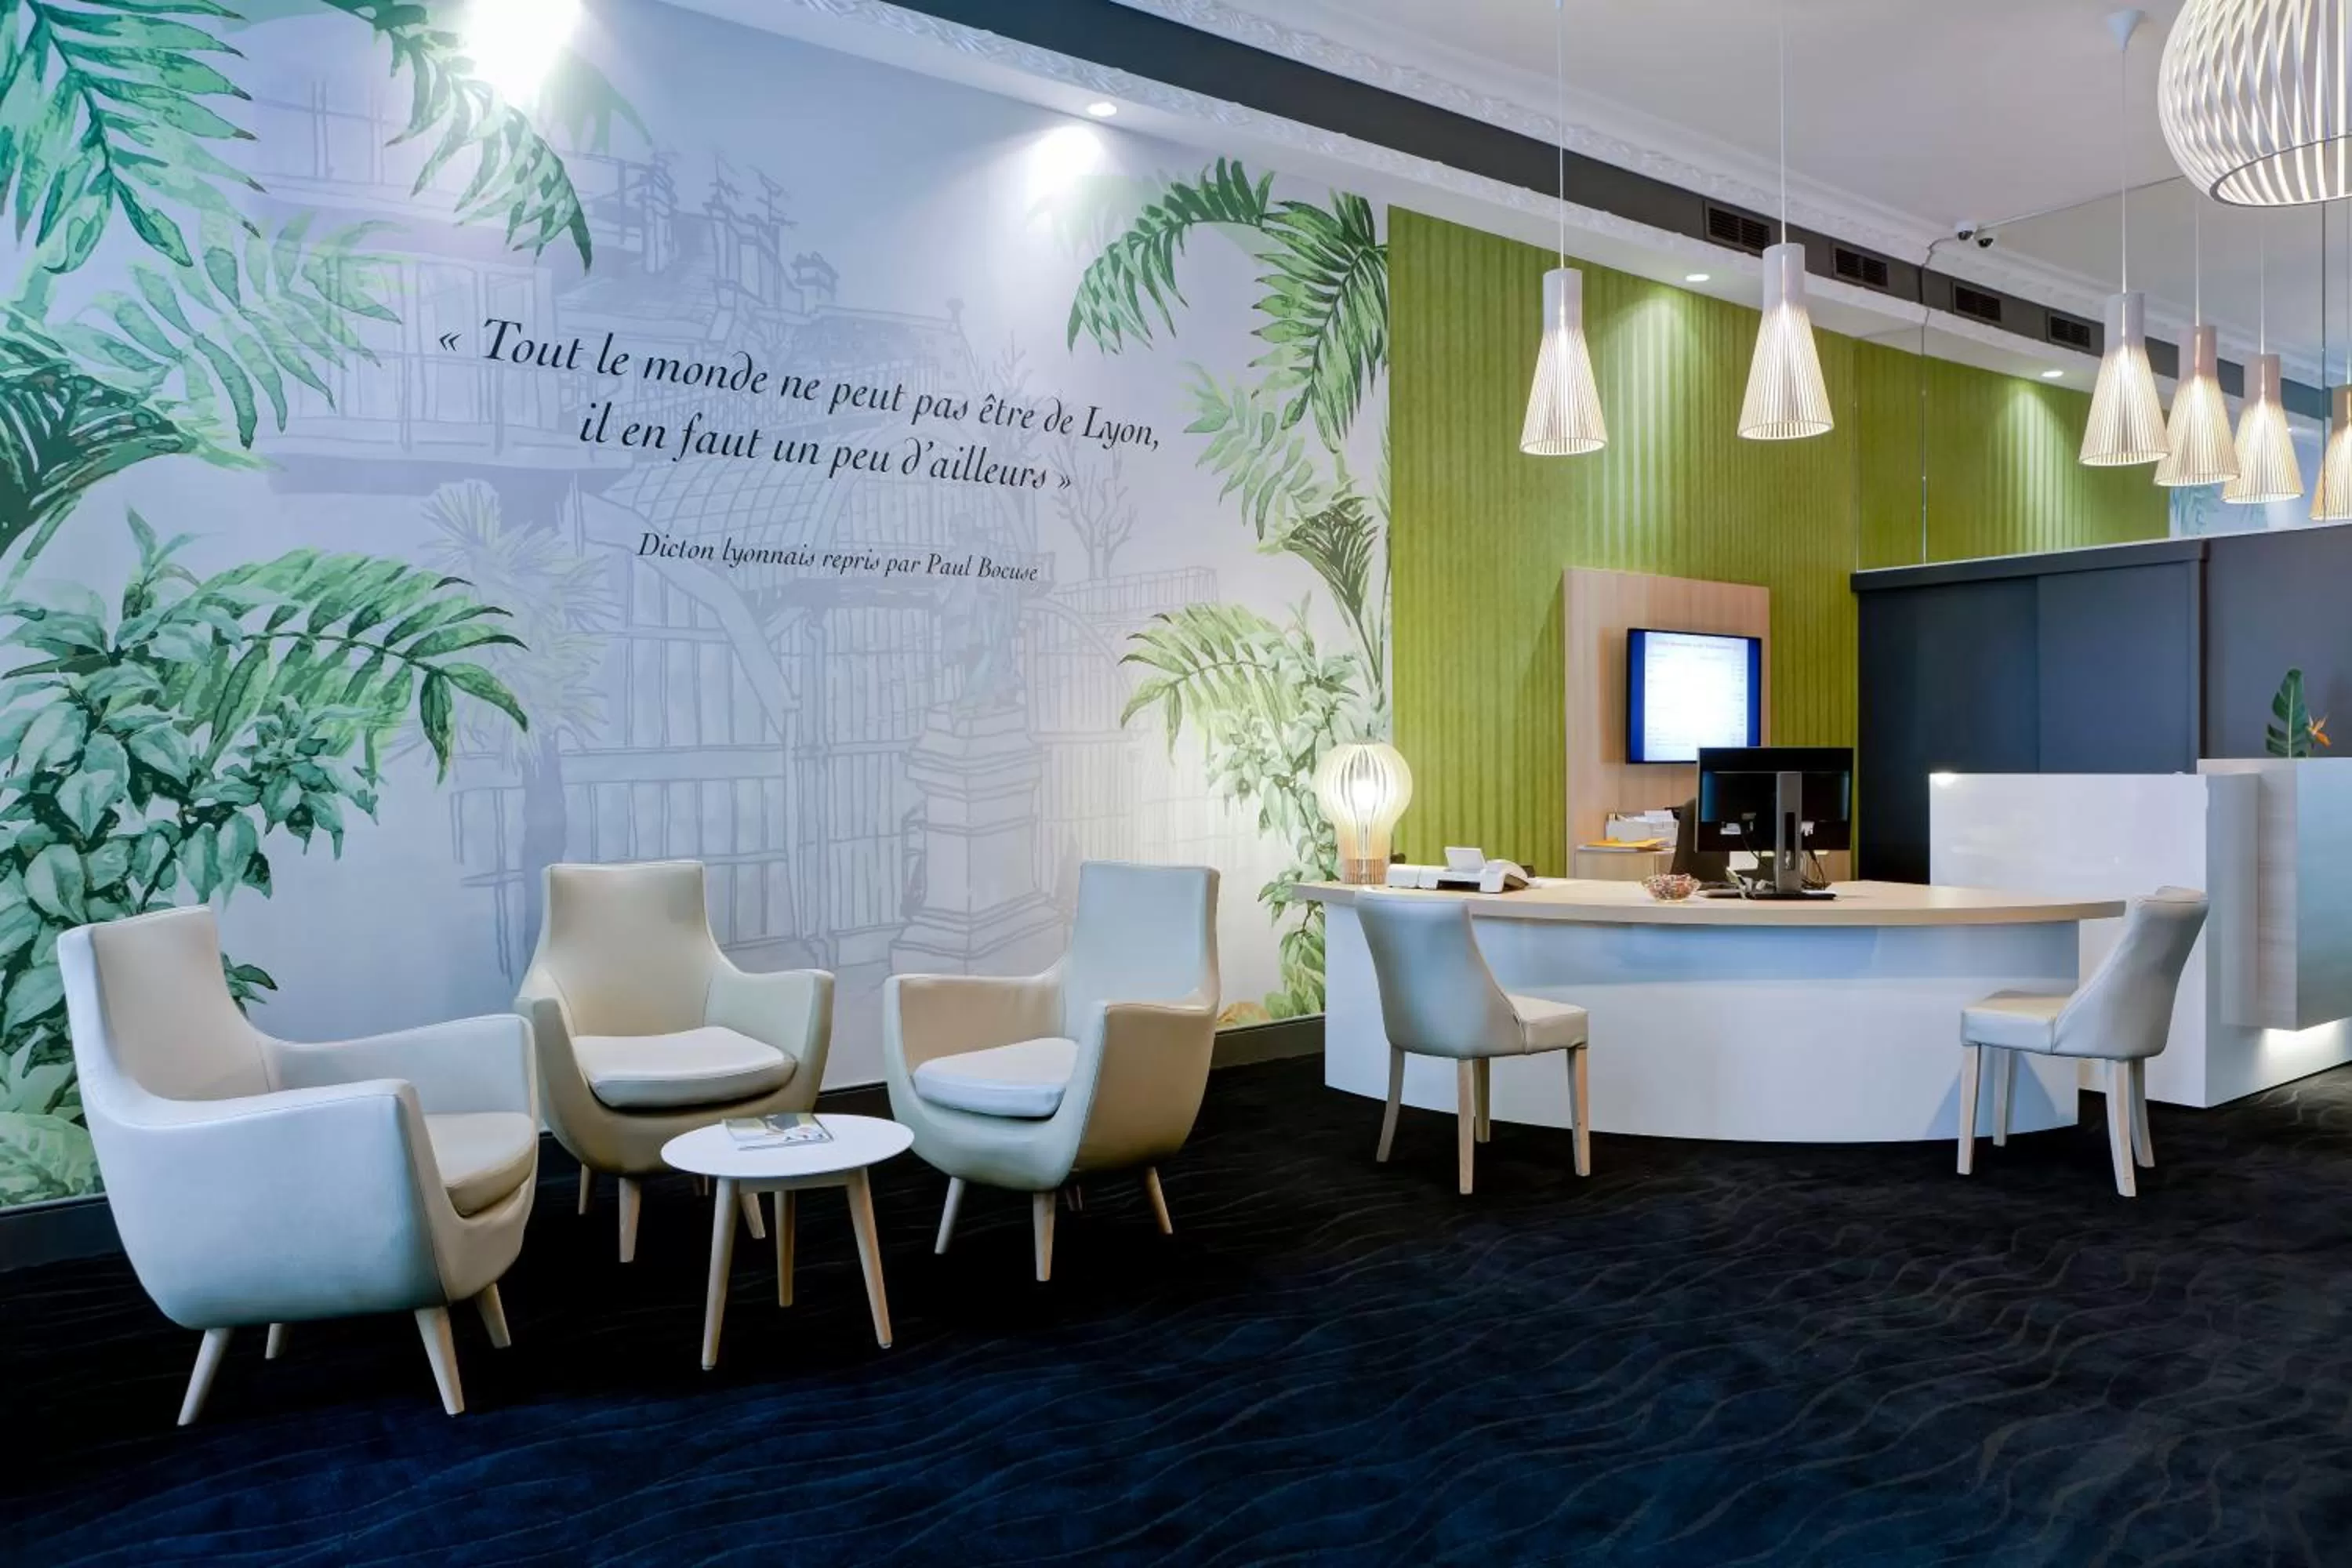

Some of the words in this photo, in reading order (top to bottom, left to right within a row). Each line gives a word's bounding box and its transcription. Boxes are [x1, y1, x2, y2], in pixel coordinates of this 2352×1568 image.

[482, 318, 584, 371] Tout
[597, 332, 630, 376] le
[643, 350, 768, 393] monde
[780, 375, 820, 401] ne
[828, 383, 903, 415] peut
[911, 394, 969, 426] pas
[978, 394, 1036, 429] être
[1043, 397, 1074, 435] de
[1083, 406, 1160, 450] Lyon,
[579, 401, 612, 444] il
[621, 421, 666, 449] en
[672, 412, 763, 462] faut
[773, 439, 819, 466] un
[829, 446, 892, 479] peu
[638, 532, 714, 561] Dicton
[722, 538, 816, 568] lyonnais
[822, 550, 880, 570] repris
[885, 557, 921, 577] par
[926, 552, 973, 578] Paul
[978, 557, 1038, 582] Bocuse
